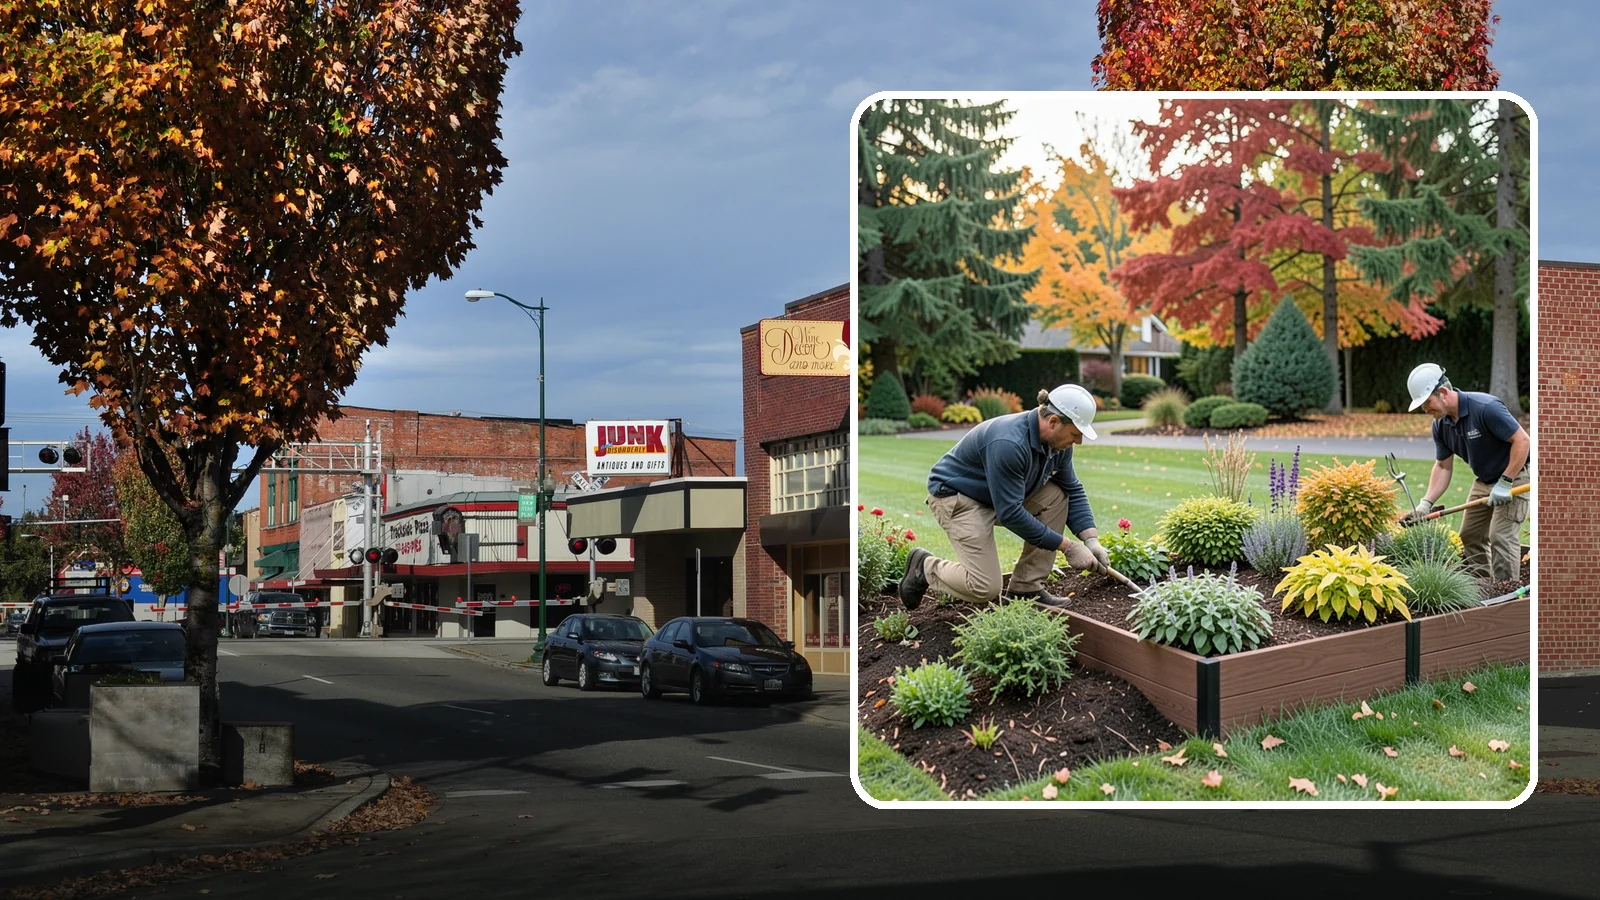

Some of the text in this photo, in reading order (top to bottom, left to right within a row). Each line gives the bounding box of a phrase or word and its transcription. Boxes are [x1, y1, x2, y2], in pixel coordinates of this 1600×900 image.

[596, 425, 664, 457] JUNK
[607, 446, 645, 454] DISORDERLY
[597, 461, 665, 469] ANTIQUES AND GIFTS
[414, 519, 429, 535] Pizza
